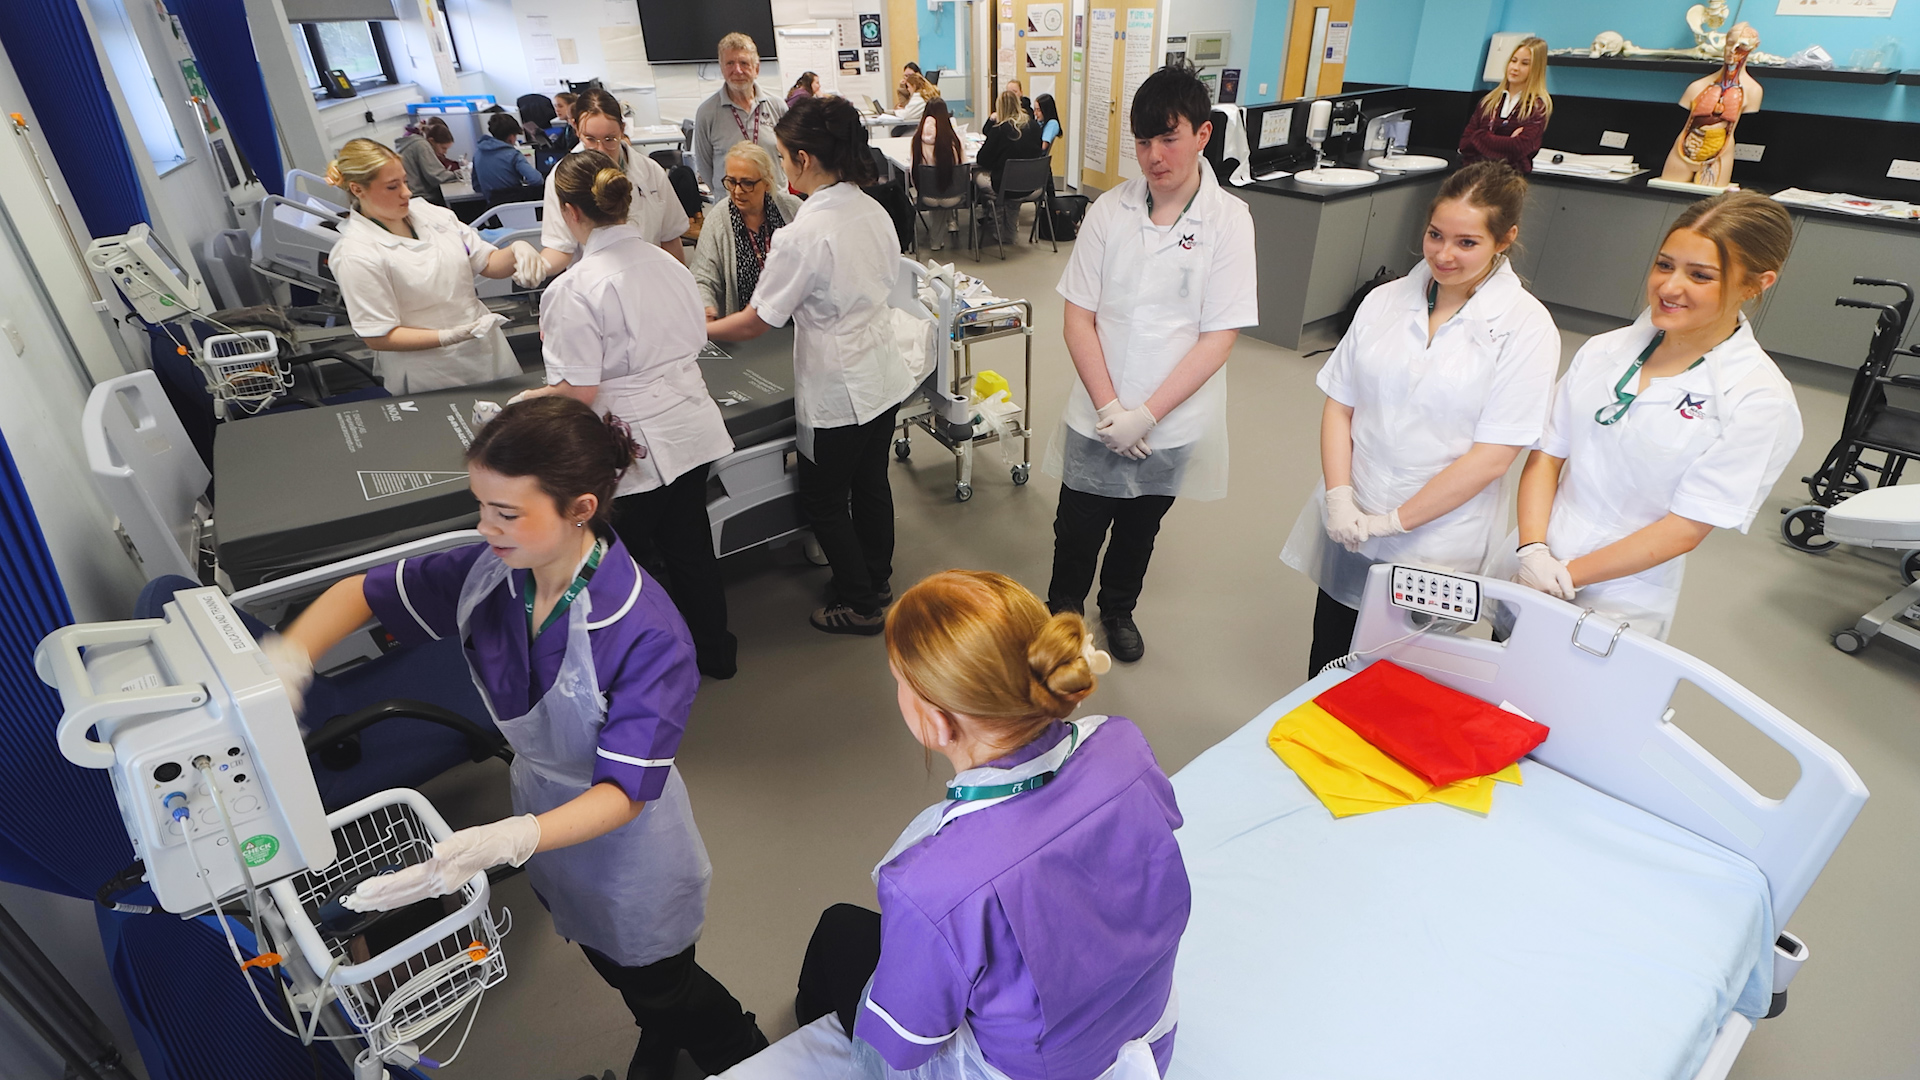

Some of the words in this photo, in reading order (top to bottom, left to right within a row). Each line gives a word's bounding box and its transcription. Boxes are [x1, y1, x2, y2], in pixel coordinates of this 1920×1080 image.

[203, 596, 221, 615] TRAINING
[215, 614, 227, 624] AND
[222, 623, 246, 649] EDUCATION
[242, 842, 272, 856] CHECK
